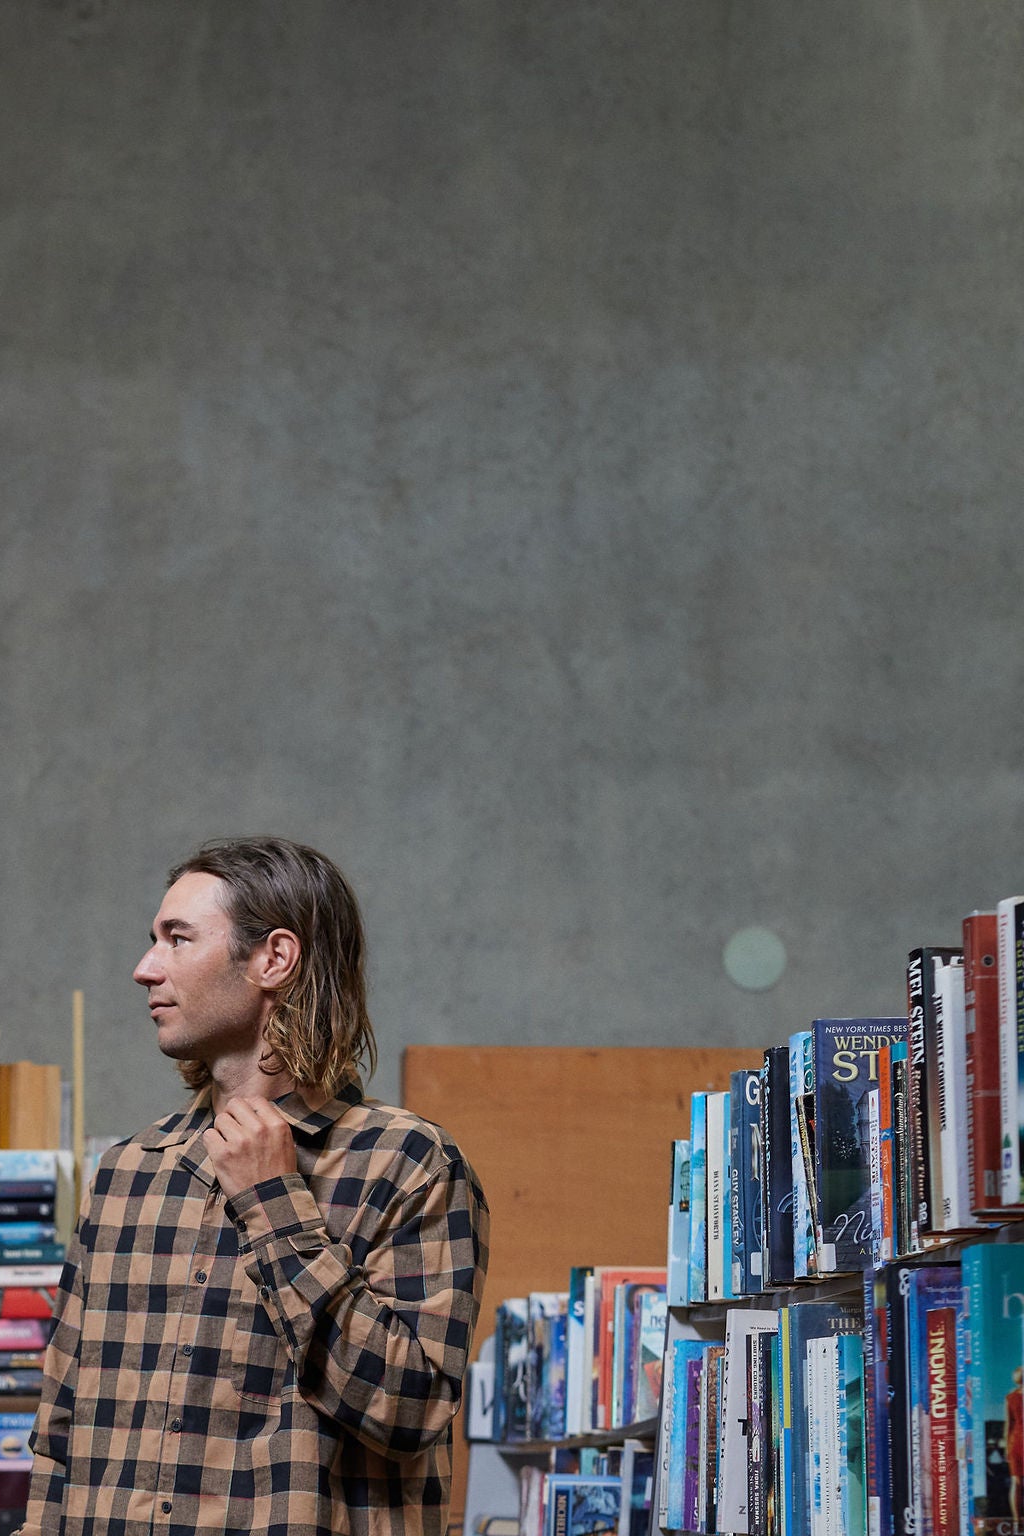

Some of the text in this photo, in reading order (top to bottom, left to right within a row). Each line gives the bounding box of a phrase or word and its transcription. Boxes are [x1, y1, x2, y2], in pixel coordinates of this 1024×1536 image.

[908, 957, 925, 1065] MEL STEIN
[999, 913, 1009, 1026] Homecoming
[834, 1035, 905, 1051] WENDY
[870, 1025, 892, 1033] TIMES
[932, 993, 947, 1133] THE WHITE CORRIDORS
[912, 1068, 925, 1197] Race Against Time
[731, 1196, 740, 1246] STANLEY
[864, 1279, 873, 1366] JAMES SWAIN
[929, 1334, 947, 1419] NOMAD
[937, 1439, 947, 1526] JAMES SWALLOW
